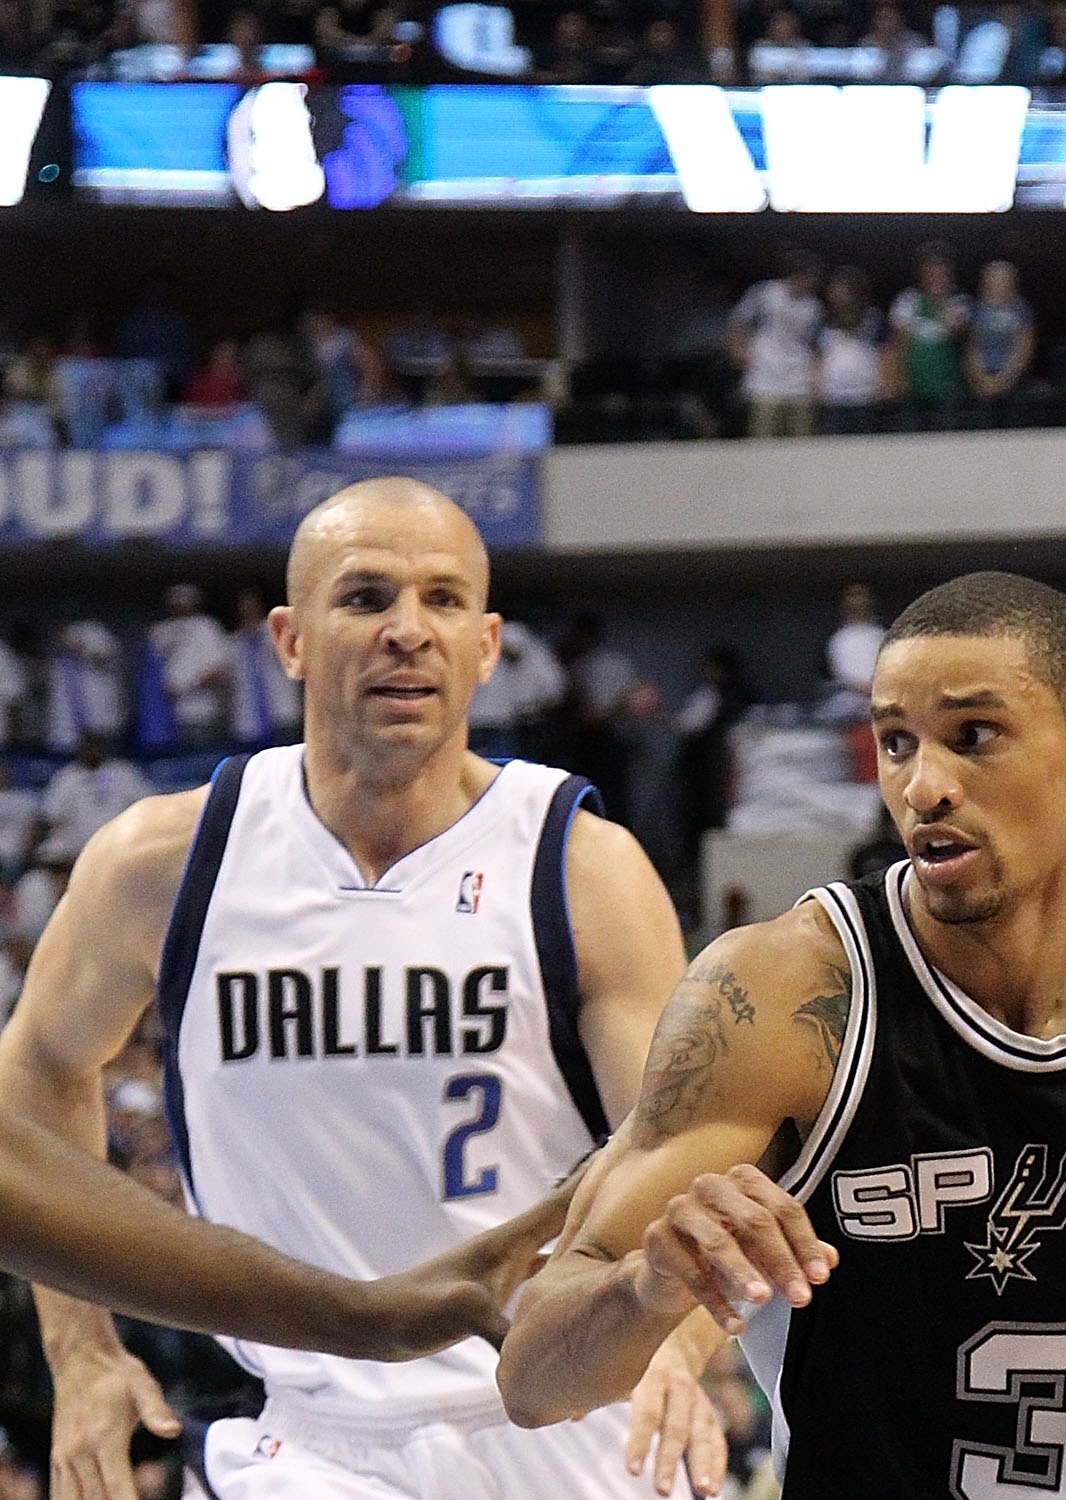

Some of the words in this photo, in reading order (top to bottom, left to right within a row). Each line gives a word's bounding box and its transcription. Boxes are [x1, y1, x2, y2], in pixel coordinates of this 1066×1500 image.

[0, 450, 231, 532] UD!
[216, 964, 511, 1063] DALLAS
[441, 1071, 503, 1202] 2
